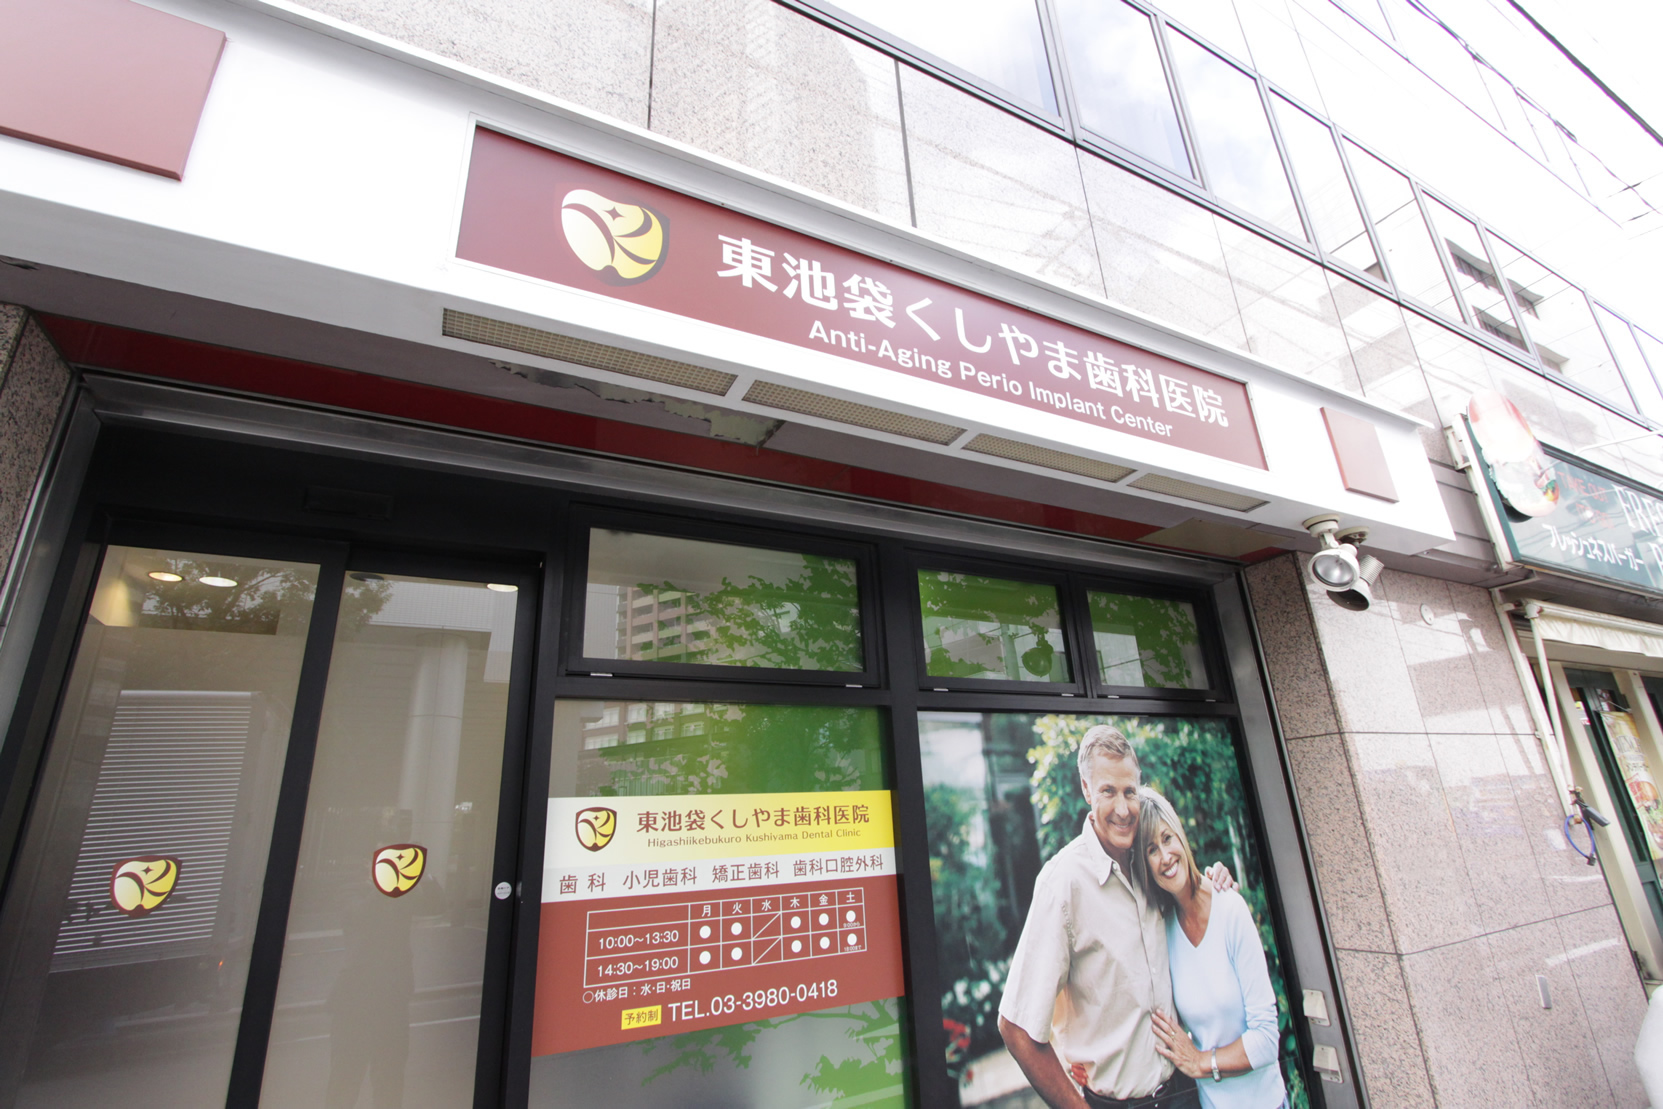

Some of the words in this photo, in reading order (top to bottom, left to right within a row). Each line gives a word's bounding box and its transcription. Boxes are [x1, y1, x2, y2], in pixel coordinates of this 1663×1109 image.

[717, 234, 1229, 428] 東池袋くしやま歯科医院
[808, 320, 953, 378] Anti-Aging
[959, 360, 1023, 396] Perio
[1028, 381, 1107, 420] Implant
[1110, 405, 1173, 437] Center
[636, 804, 870, 833] 東池袋くしやま歯科医院
[647, 833, 742, 848] Higashiikebukuro
[745, 830, 798, 842] Kushiyama
[801, 829, 833, 840] Dental
[835, 828, 861, 838] Clinic
[622, 866, 697, 890] 小児歯科
[711, 861, 780, 884] 矯正歯科
[793, 853, 883, 877] 歯科口腔外科
[701, 904, 712, 918] 月
[732, 902, 743, 915] 火
[761, 899, 772, 912] 水
[790, 897, 801, 909] 木
[818, 894, 829, 906] 金
[846, 892, 856, 903] 土
[624, 1008, 659, 1026] 予約制
[668, 979, 838, 1022] TEL.03-3980-0418
